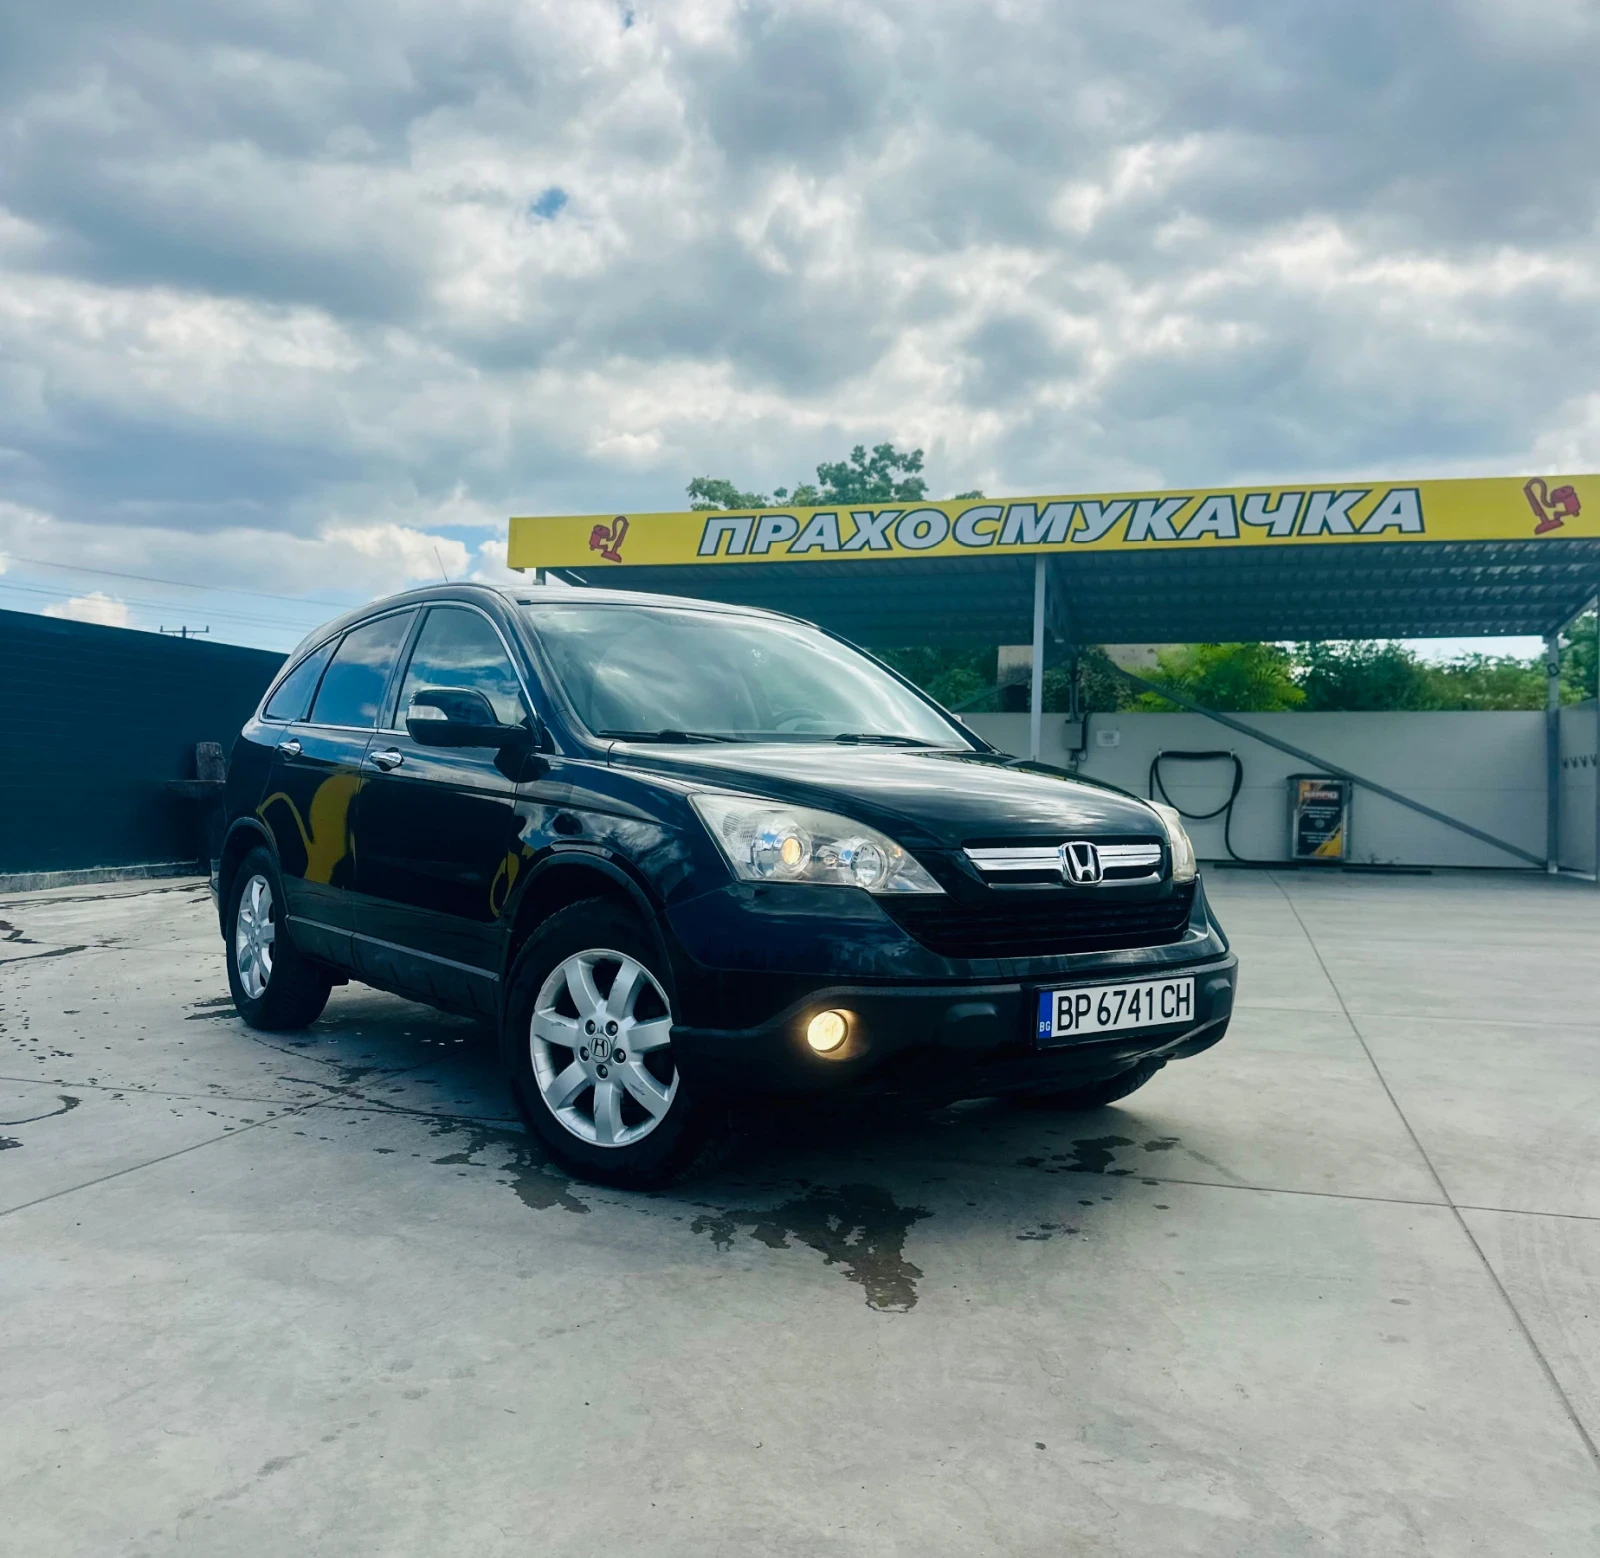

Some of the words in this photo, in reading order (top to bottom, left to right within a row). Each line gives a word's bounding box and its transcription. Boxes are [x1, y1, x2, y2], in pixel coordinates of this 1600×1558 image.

[697, 488, 1425, 556] ПРАХОСМУКАЧКА
[1039, 1021, 1051, 1032] BG
[1057, 994, 1091, 1031] BP
[1097, 987, 1153, 1026] 6741
[1161, 983, 1190, 1018] CH
